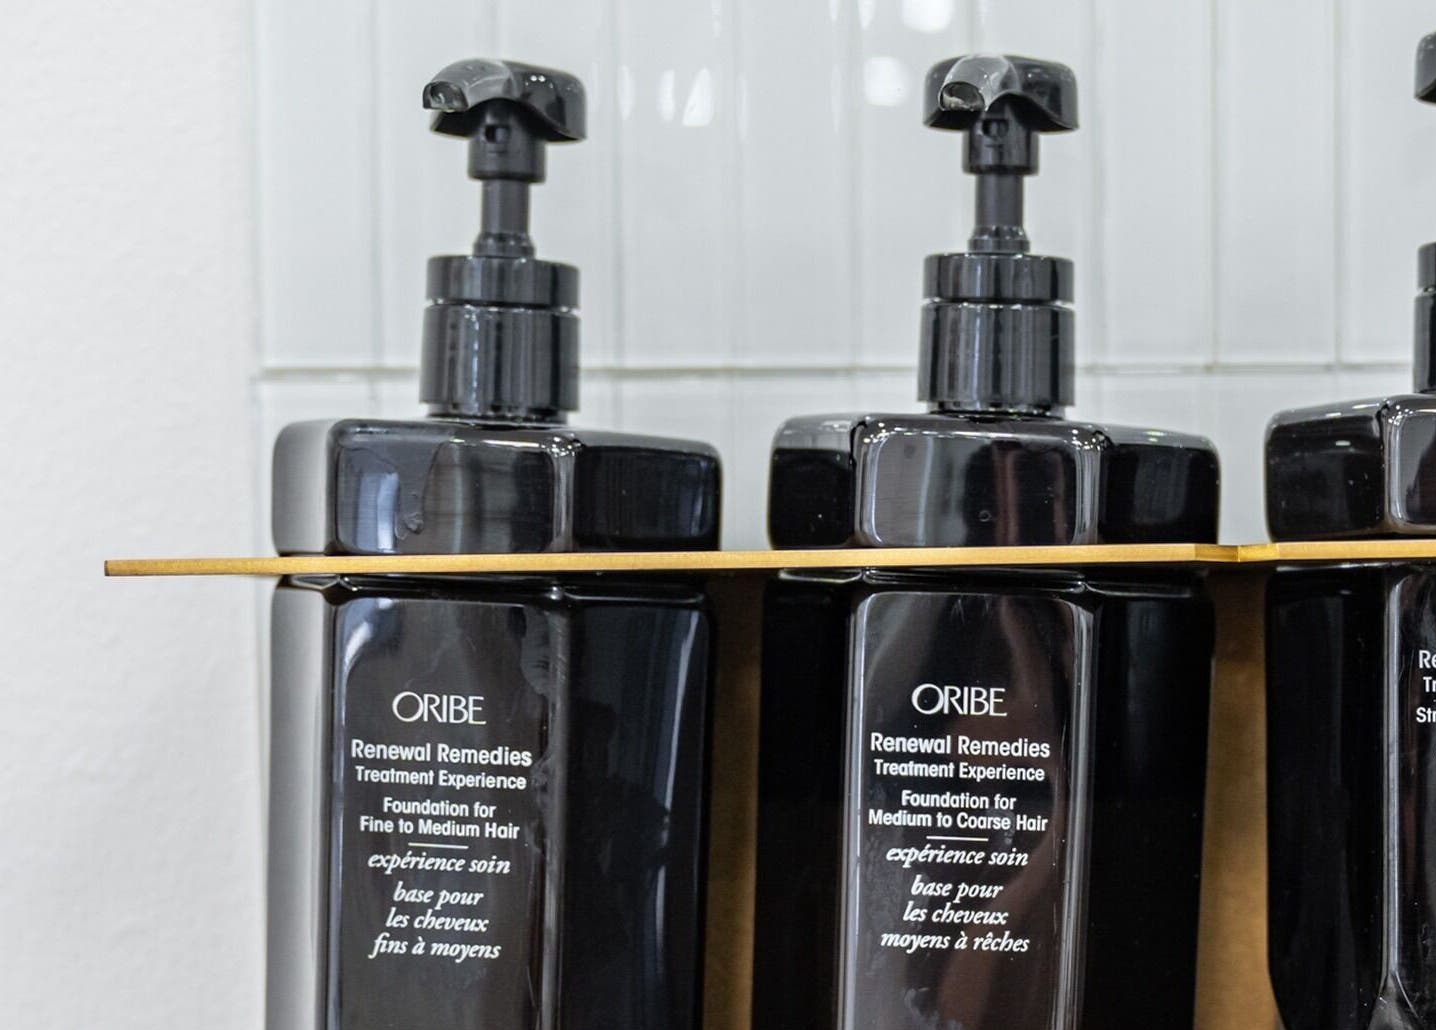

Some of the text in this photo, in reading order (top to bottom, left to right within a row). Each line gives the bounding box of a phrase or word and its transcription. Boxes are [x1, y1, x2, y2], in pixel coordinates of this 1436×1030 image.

[392, 691, 487, 725] ORIBE
[911, 683, 1007, 717] ORIBE
[351, 738, 533, 767] Renewal Remedies
[870, 732, 1050, 758] Renewal Remedies
[355, 765, 527, 790] Treatment Experience
[874, 759, 1045, 782] Treatment Experience
[383, 797, 496, 818] Foundation for
[901, 789, 1017, 810] Foundation for
[360, 815, 520, 839] Fine to Medium Hair
[868, 808, 1049, 832] Medium to Coarse Hair
[367, 852, 511, 874] expérience soin
[886, 845, 1029, 868] expérience soin
[393, 880, 485, 910] base pour
[911, 874, 1004, 903] base pour
[385, 907, 489, 932] les cheveux
[902, 901, 1009, 925] les cheveux
[368, 933, 501, 963] fins à moyens
[881, 931, 1030, 954] moyens à rêches
